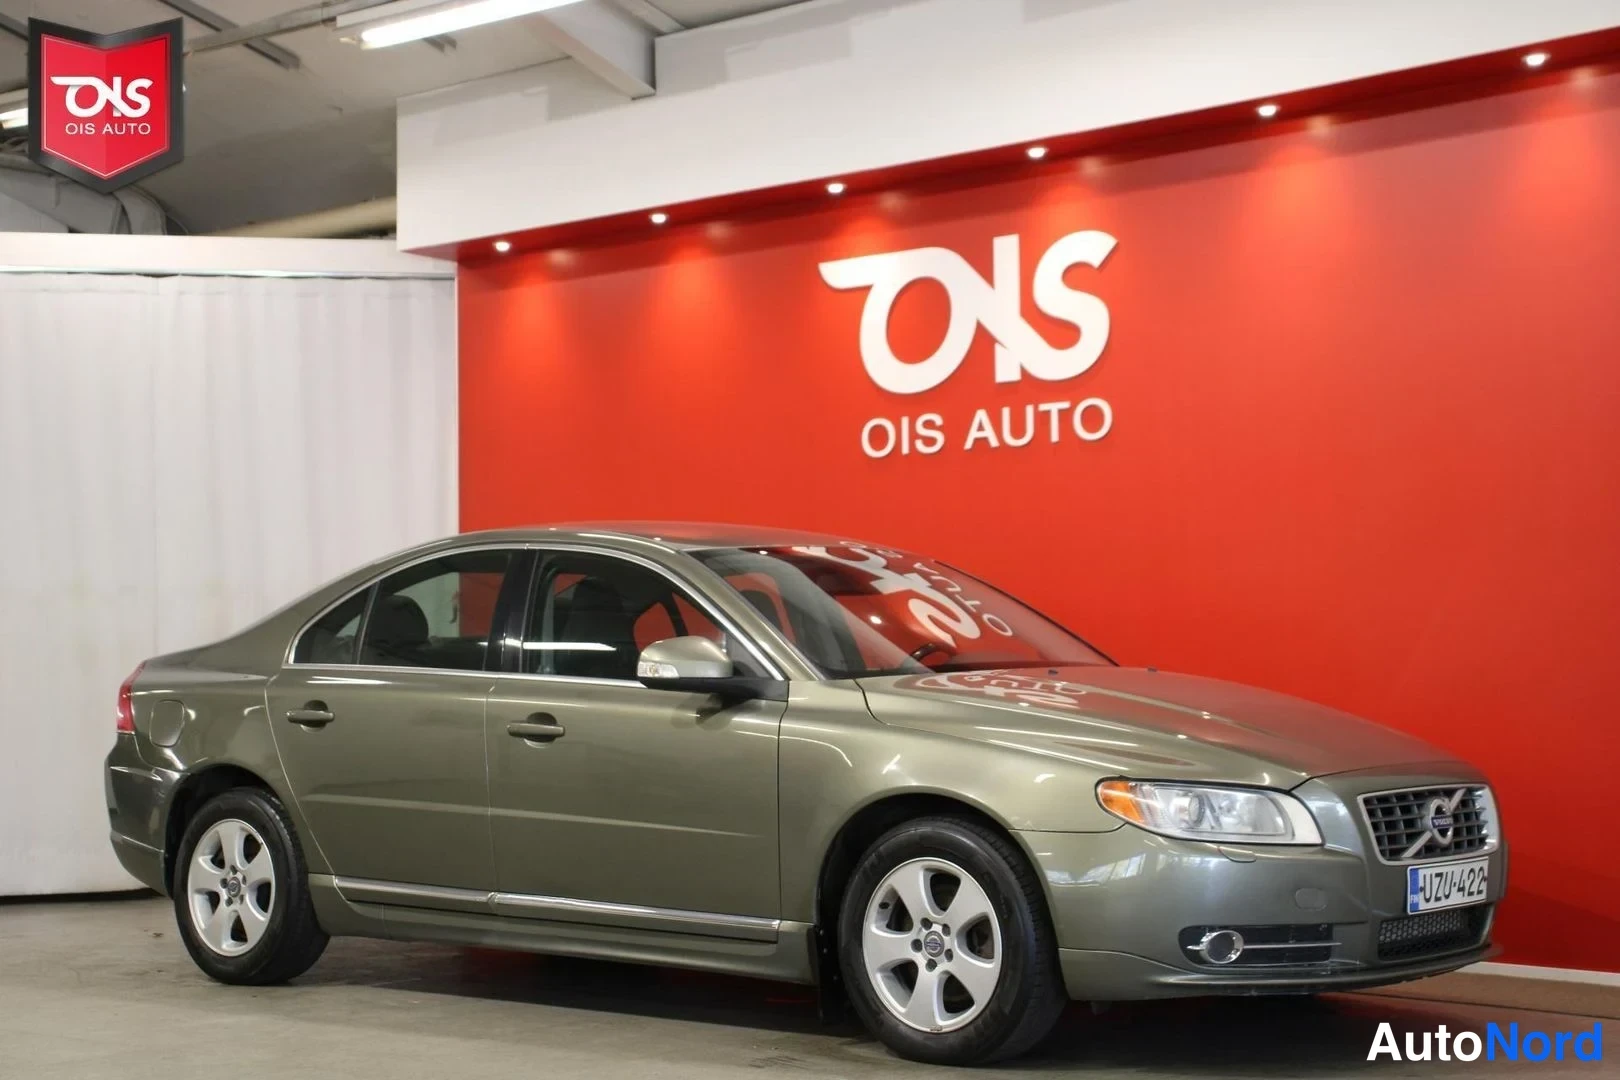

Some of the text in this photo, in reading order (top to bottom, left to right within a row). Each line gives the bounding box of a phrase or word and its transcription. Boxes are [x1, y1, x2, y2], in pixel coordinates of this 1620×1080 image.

[861, 397, 1113, 458] OIS AUTO
[1423, 866, 1485, 903] UZU-422
